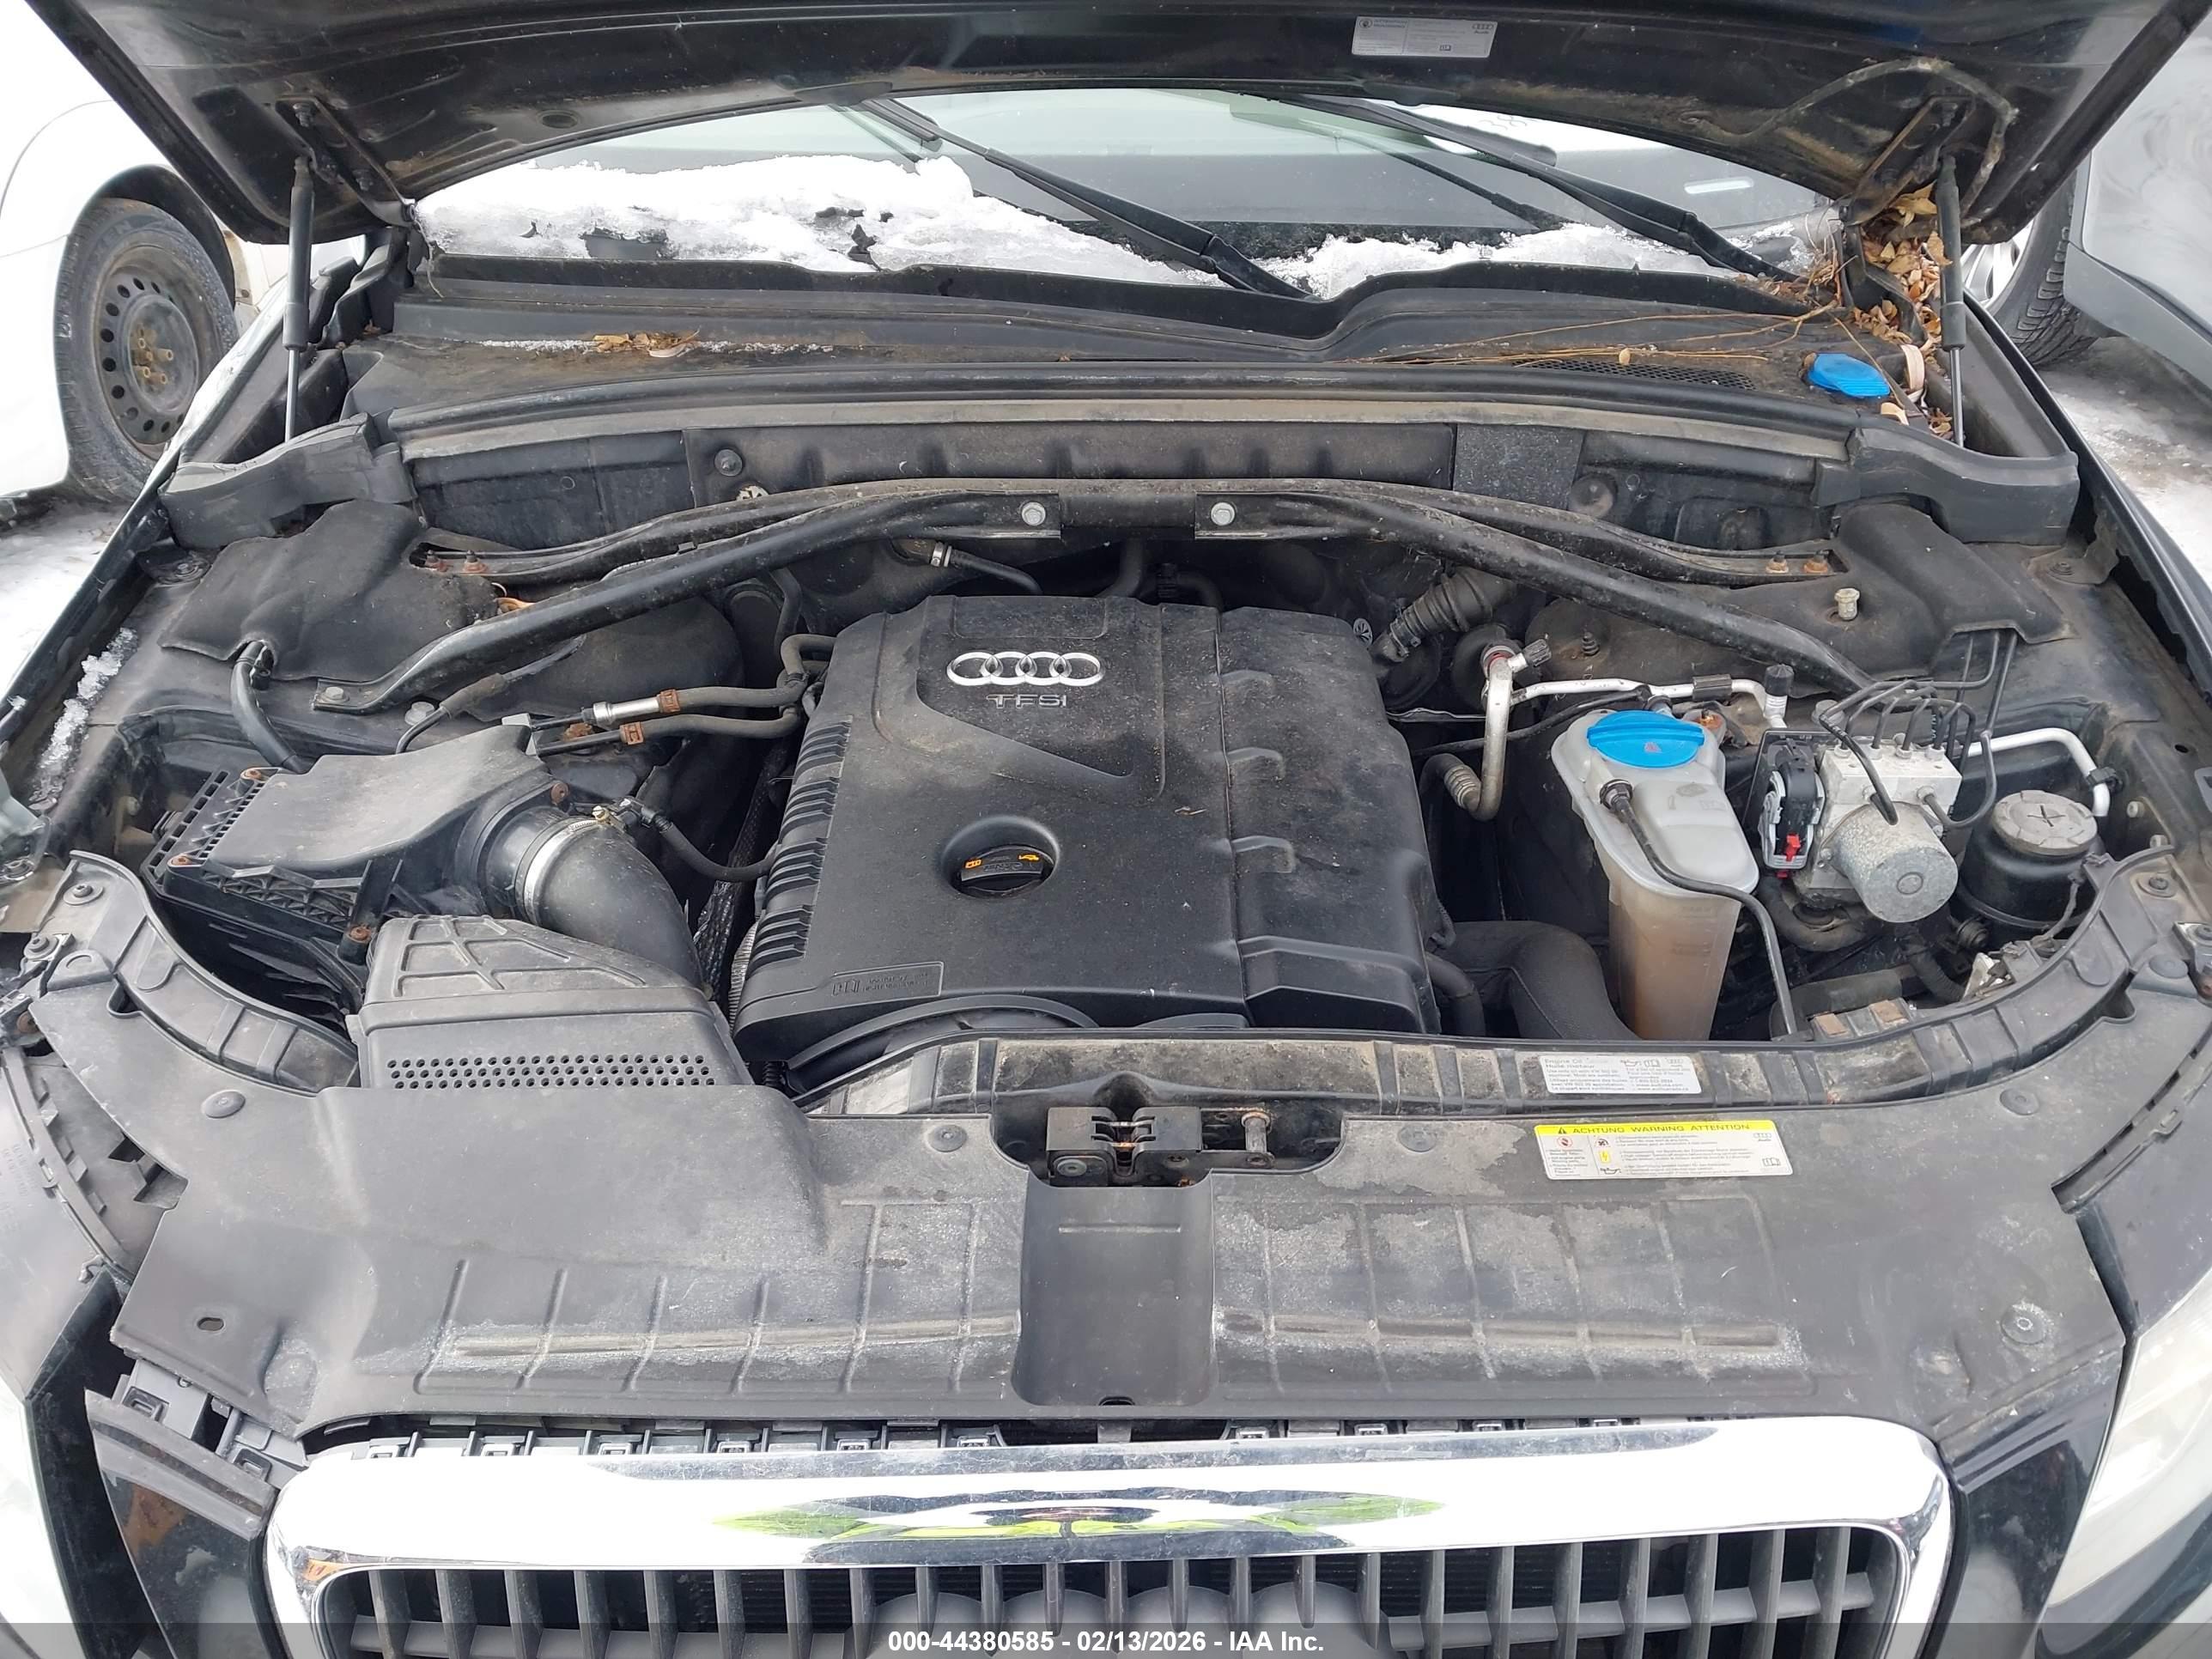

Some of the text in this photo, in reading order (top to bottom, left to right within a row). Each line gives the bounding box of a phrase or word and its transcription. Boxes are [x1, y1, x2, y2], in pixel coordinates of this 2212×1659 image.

[986, 694, 1067, 708] TFSI
[1572, 1123, 1750, 1134] ACHTUNG WARNING ATTENTION
